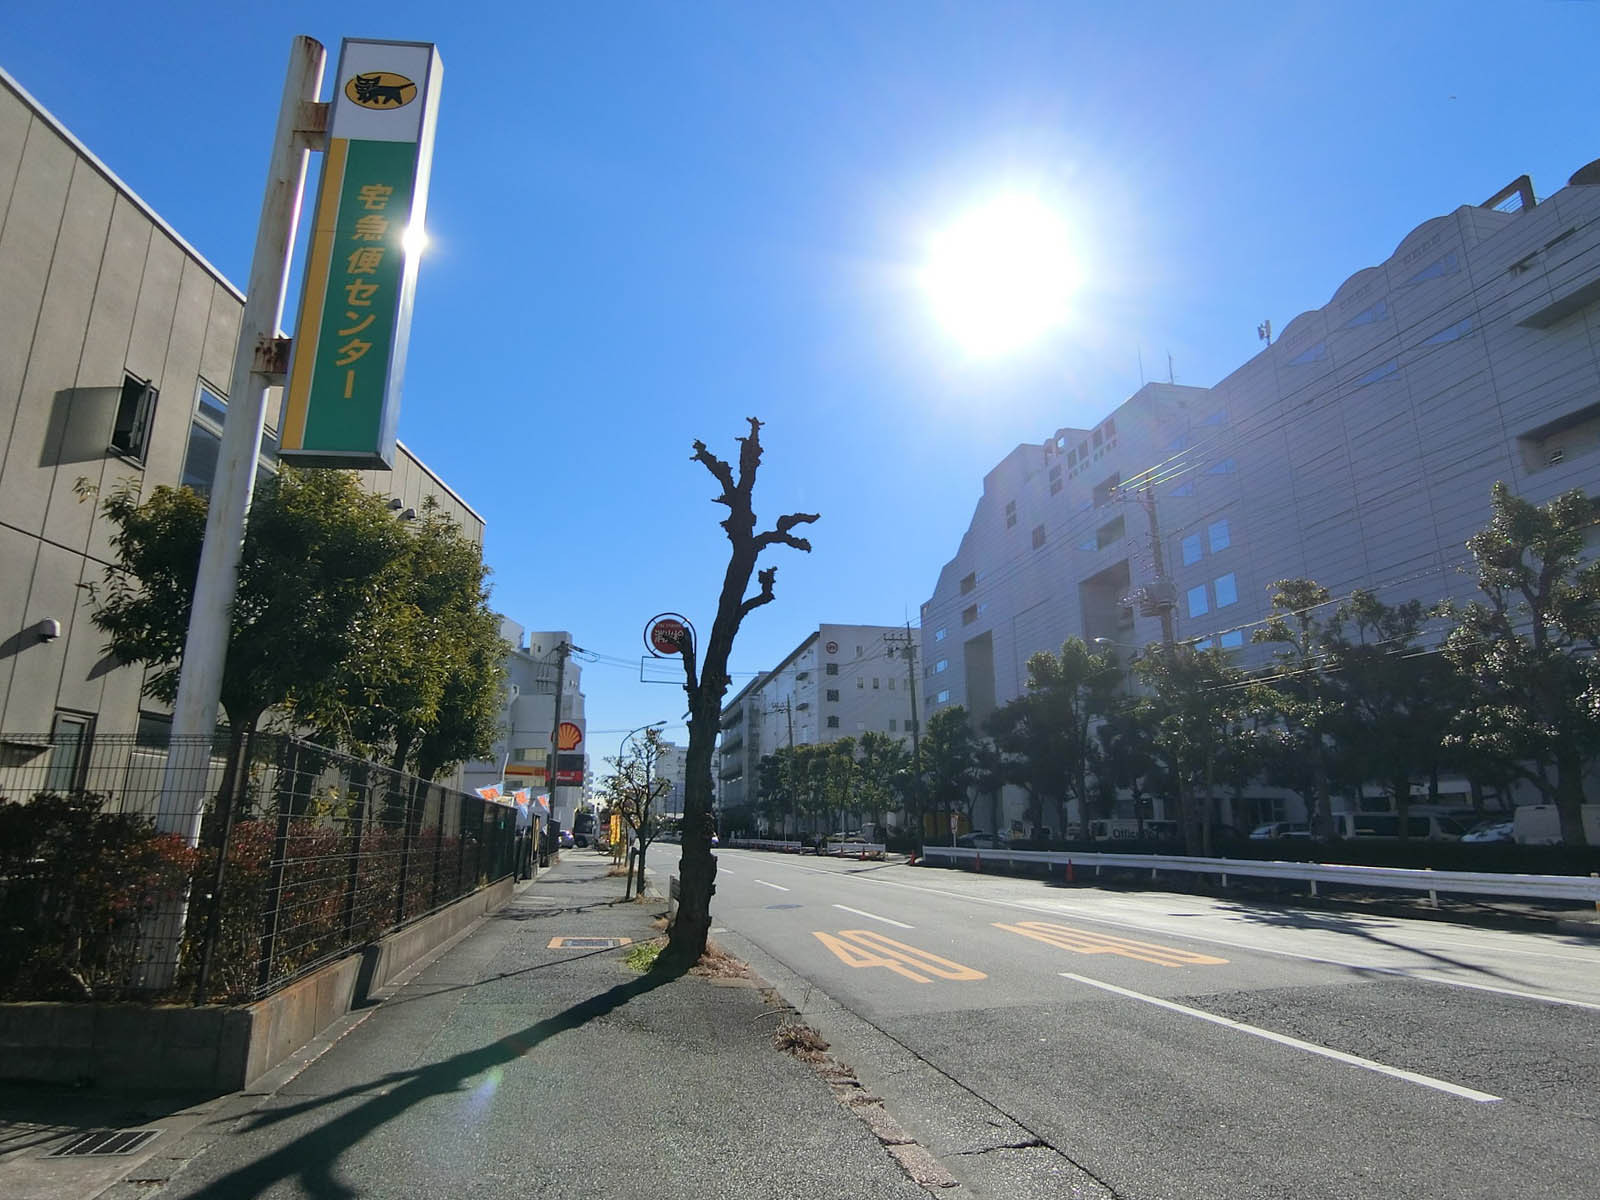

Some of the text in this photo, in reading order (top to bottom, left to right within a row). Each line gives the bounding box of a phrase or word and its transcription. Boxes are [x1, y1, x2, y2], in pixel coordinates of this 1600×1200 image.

[336, 184, 393, 398] 宅急便センター
[812, 931, 987, 983] 40
[993, 922, 1229, 966] 40
